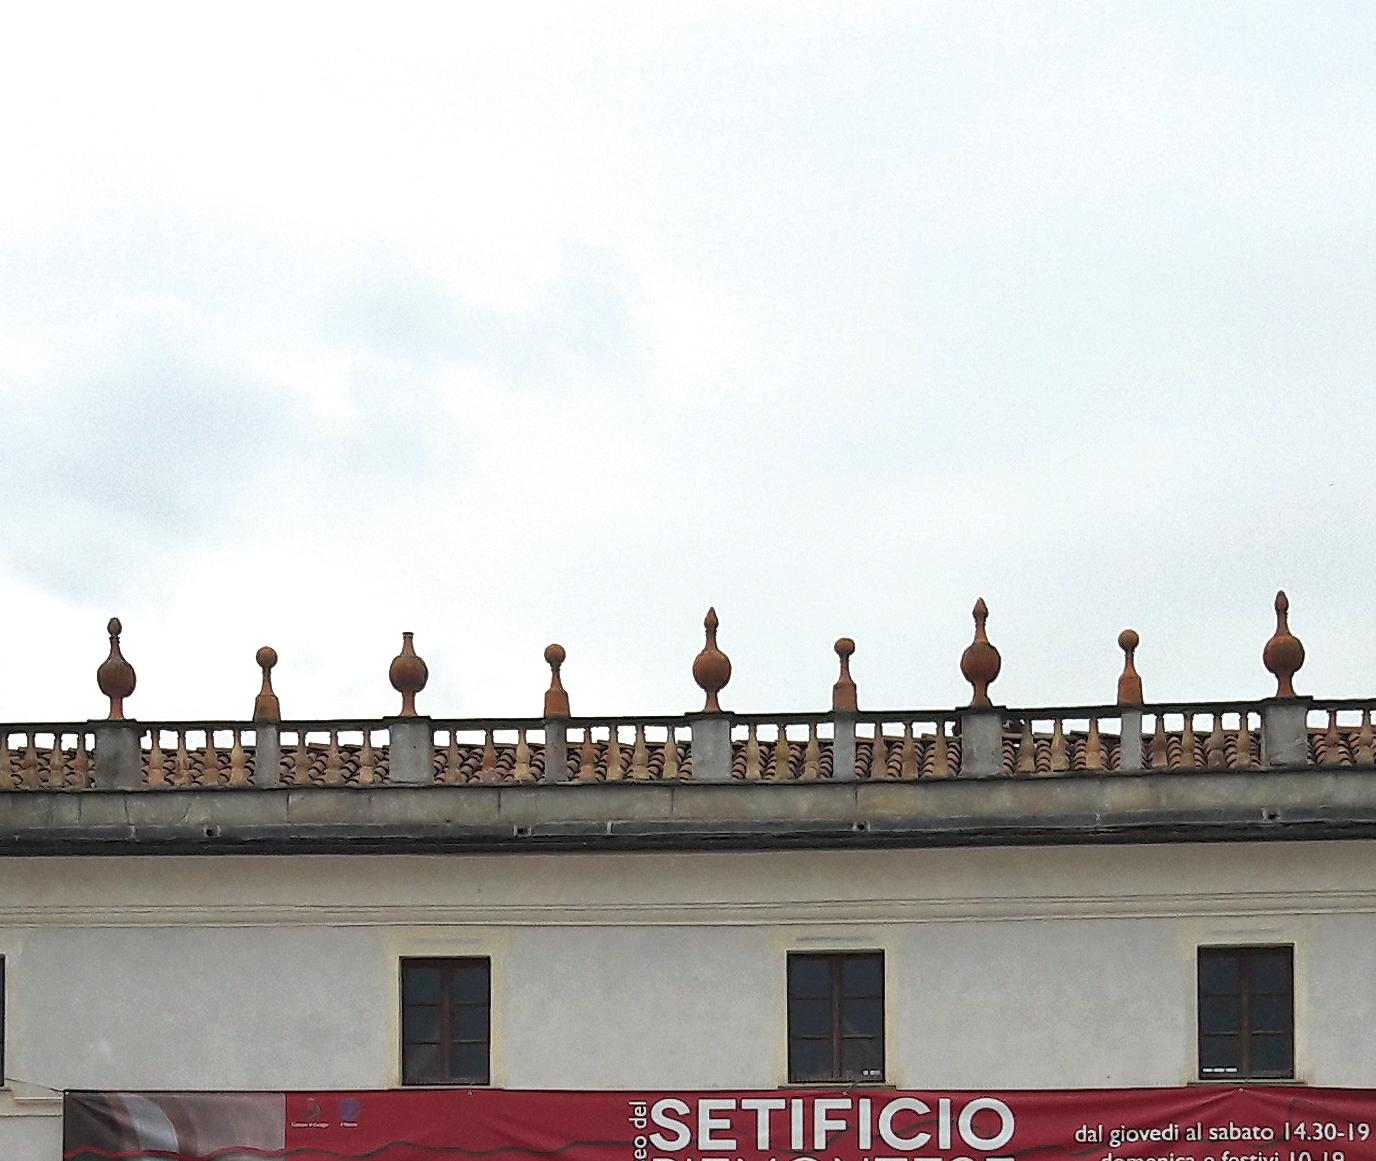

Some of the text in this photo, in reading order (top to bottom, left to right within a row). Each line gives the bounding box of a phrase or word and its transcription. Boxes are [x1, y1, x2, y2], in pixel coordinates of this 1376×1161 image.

[628, 1101, 647, 1129] del
[649, 1094, 1015, 1152] SETIFICIO
[1075, 1124, 1104, 1143] dal
[1186, 1122, 1203, 1141] al
[1208, 1121, 1274, 1141] sabato
[1284, 1122, 1370, 1141] 14.30-19
